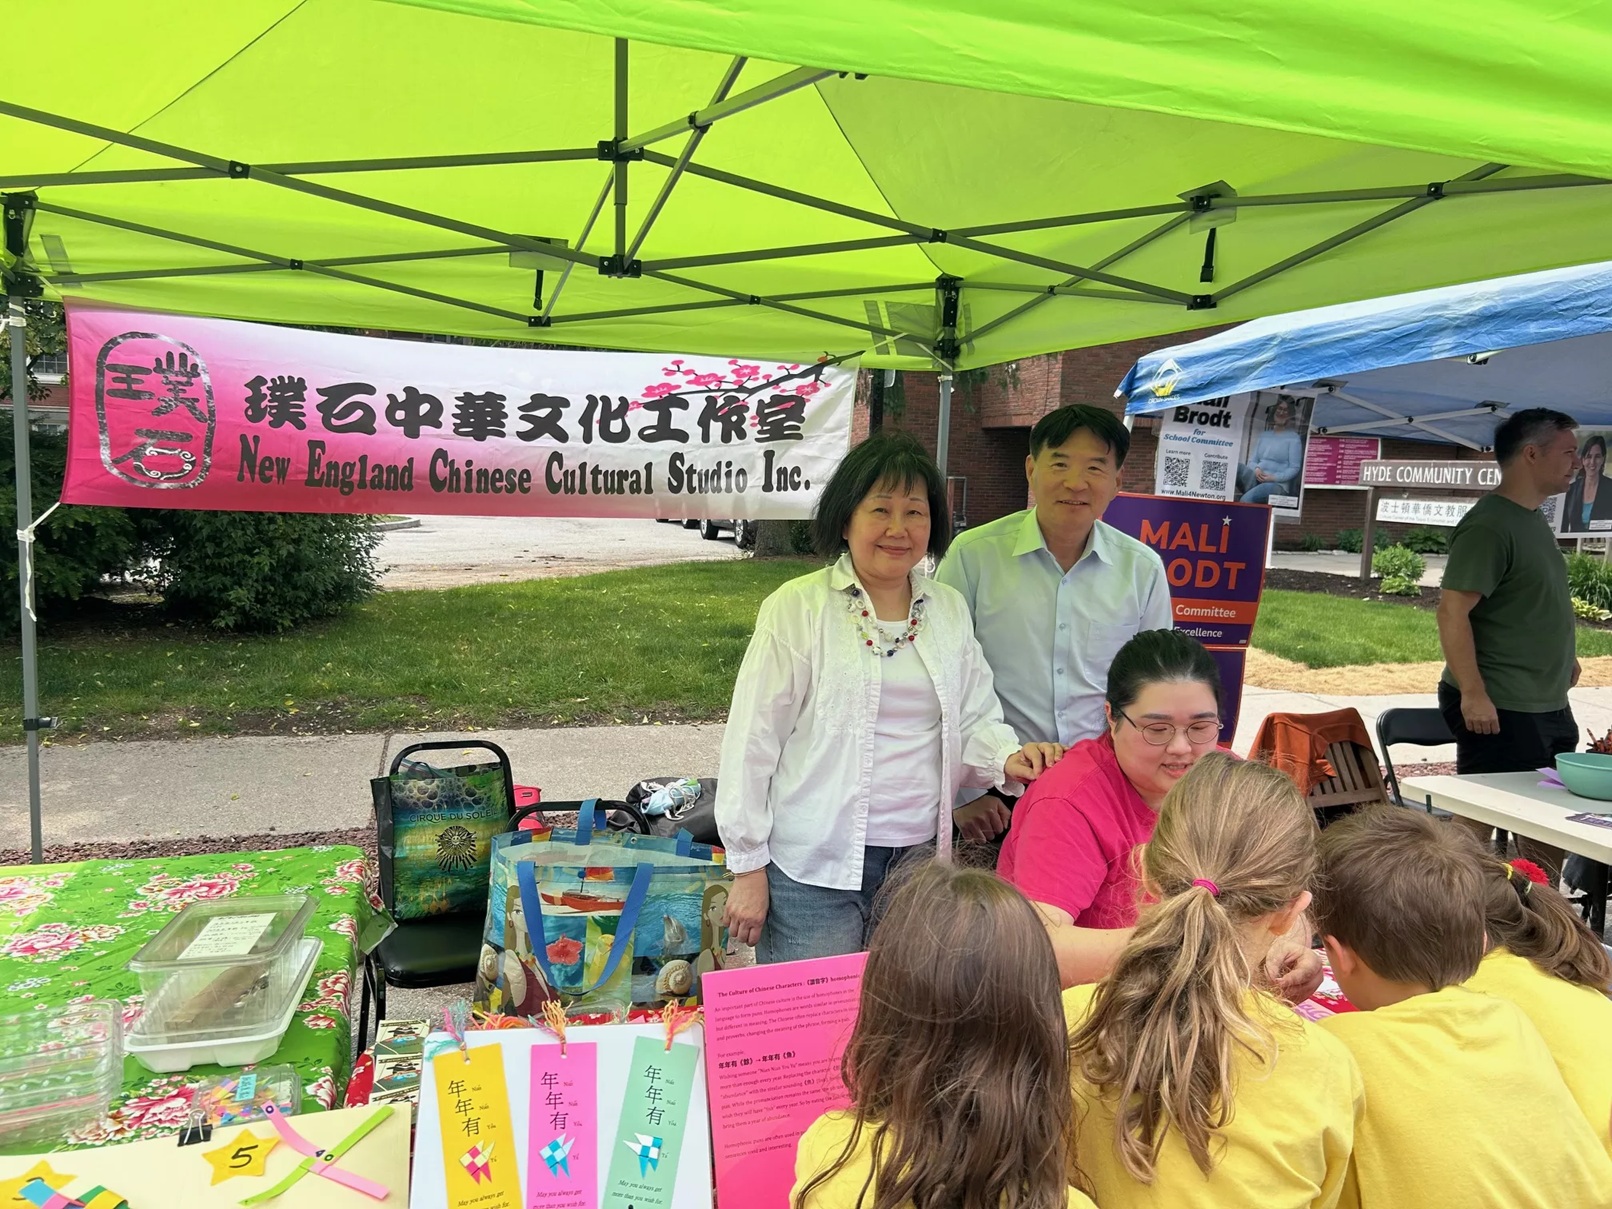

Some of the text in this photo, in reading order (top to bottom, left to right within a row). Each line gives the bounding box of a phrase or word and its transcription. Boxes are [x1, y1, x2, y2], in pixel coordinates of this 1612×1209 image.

[1172, 405, 1232, 429] Brodt
[1193, 428, 1206, 436] for
[1163, 433, 1234, 448] School Committee
[1204, 452, 1229, 460] Contribute
[236, 433, 811, 496] New England Chinese Cultural Studio Inc.
[1362, 465, 1502, 486] HYDE COMMUNITY CEN
[1160, 488, 1226, 502] www.Mali4Newton.org
[1166, 557, 1246, 590] ODT
[1175, 604, 1236, 618] Committee
[409, 808, 498, 824] CIRQUE DU SOLEIL
[775, 981, 802, 989] Characters
[643, 1064, 666, 1126] 年年有
[228, 1143, 259, 1169] 5
[618, 1179, 629, 1187] May
[638, 1183, 654, 1192] always
[479, 1193, 496, 1202] always
[557, 1189, 573, 1197] always
